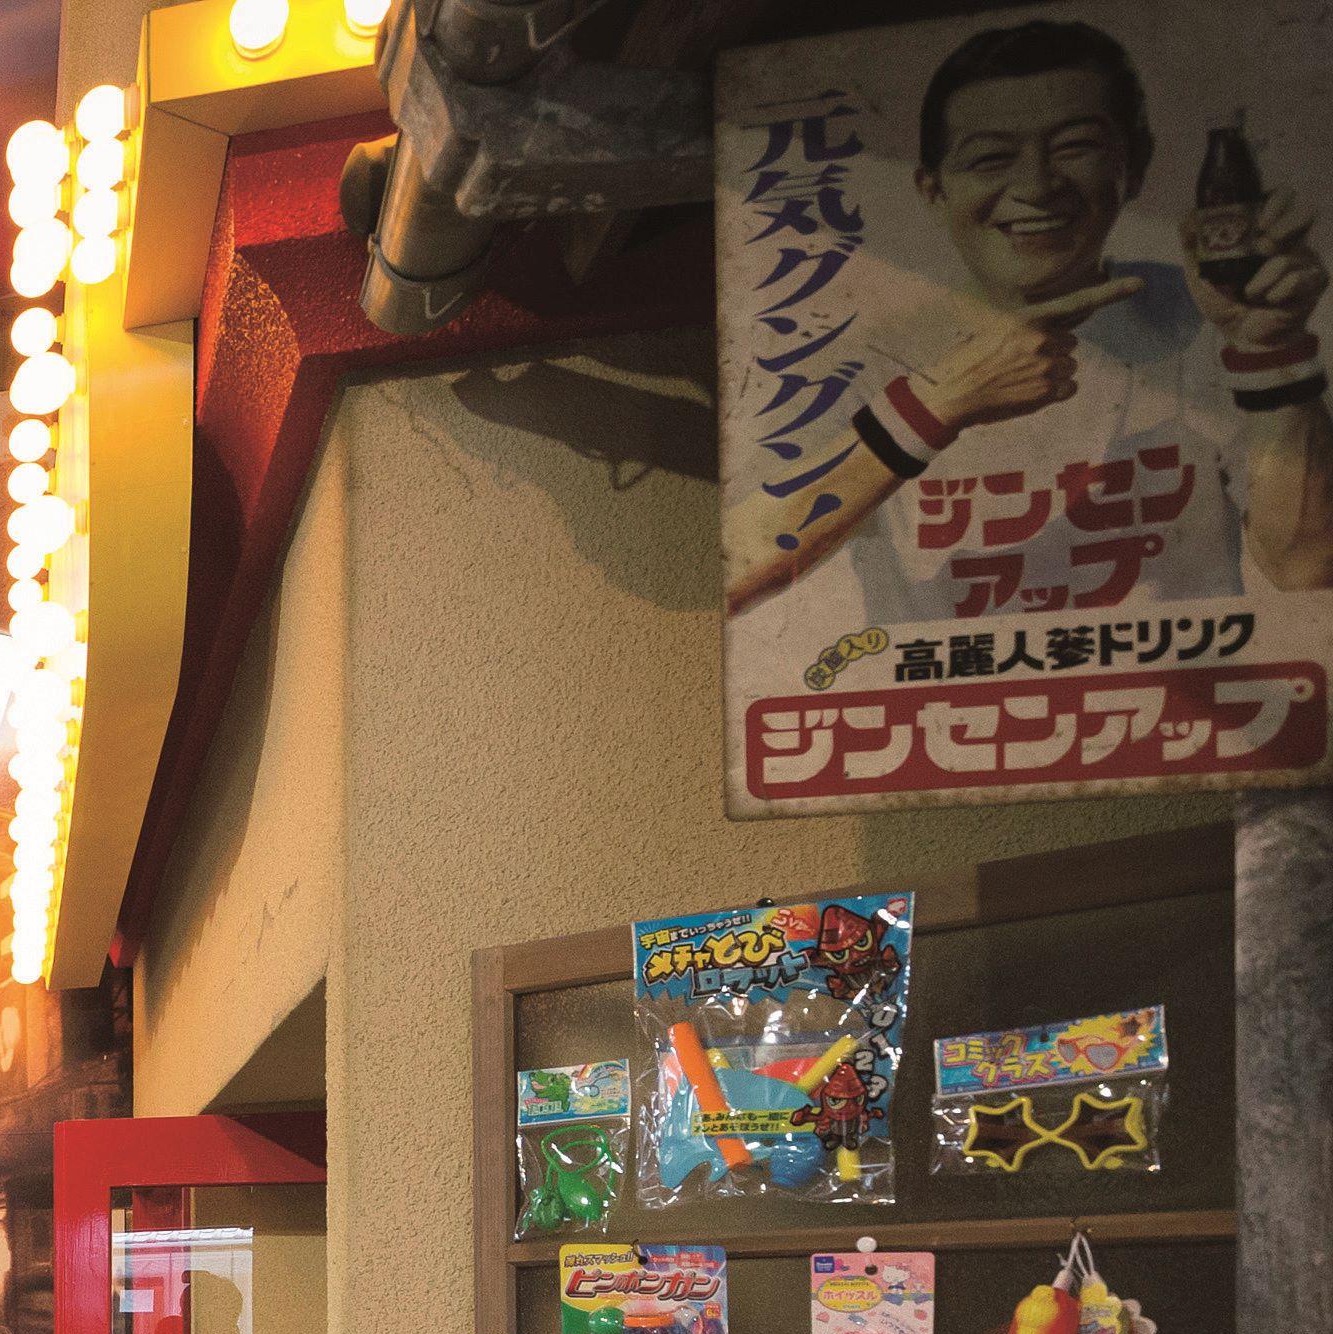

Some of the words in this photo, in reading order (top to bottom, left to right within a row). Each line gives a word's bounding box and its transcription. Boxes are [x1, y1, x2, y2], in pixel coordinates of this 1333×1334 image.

[918, 445, 1197, 551] ジンセン
[951, 538, 1163, 618] アップ
[761, 678, 1314, 784] ジンセンアップ
[944, 1034, 1027, 1066] コミック
[823, 1289, 877, 1300] ホイッスル
